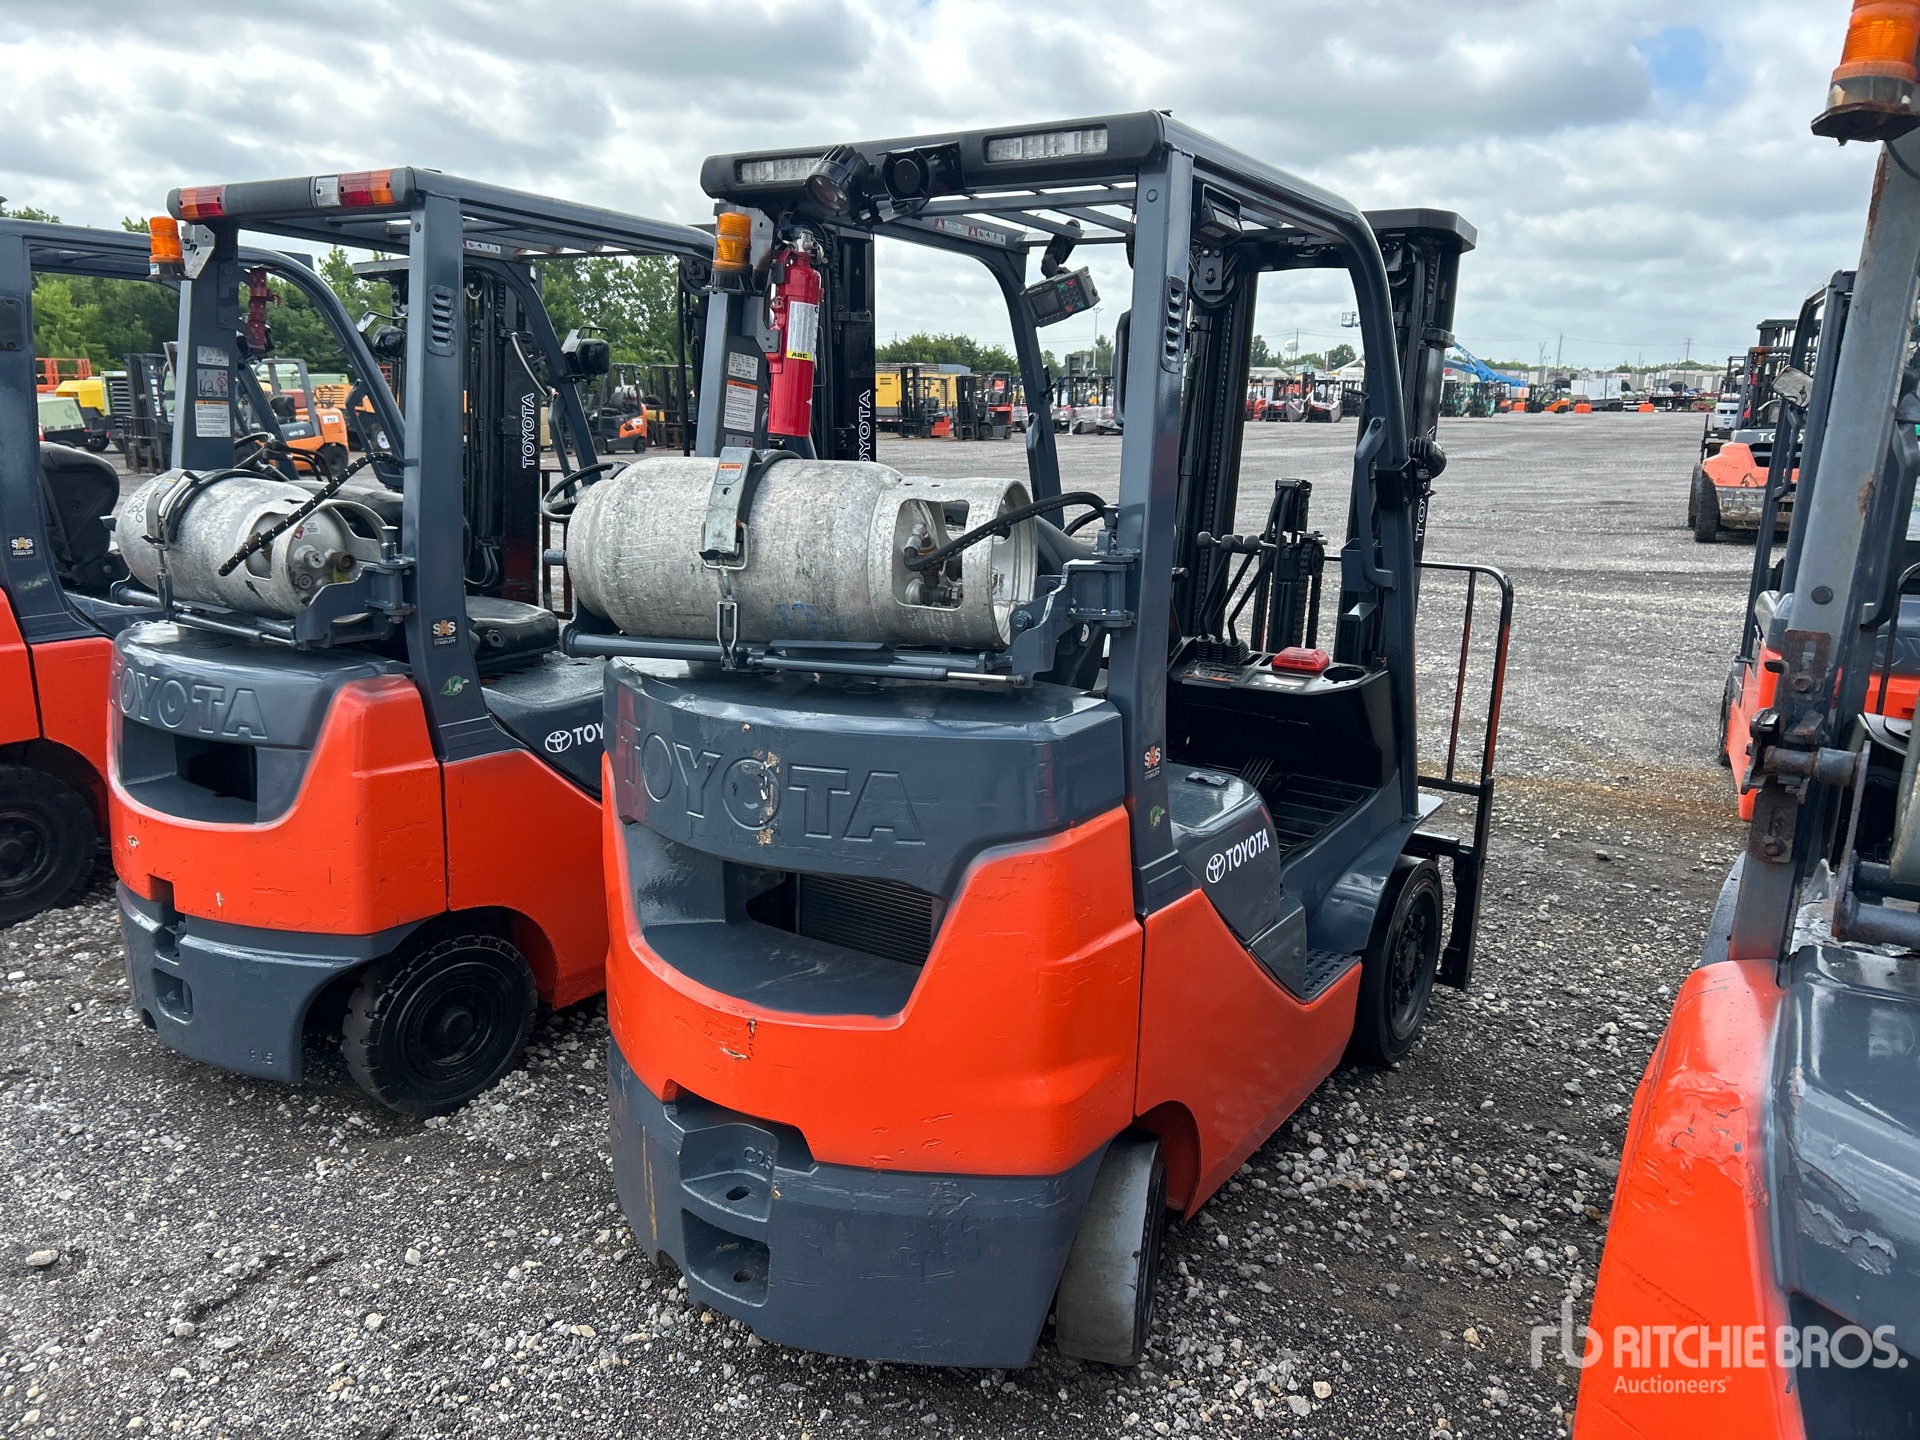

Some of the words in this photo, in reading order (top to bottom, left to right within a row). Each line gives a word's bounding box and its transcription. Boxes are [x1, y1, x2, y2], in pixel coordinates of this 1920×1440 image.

[521, 392, 535, 469] TOYOTA
[11, 536, 33, 549] SAS
[432, 619, 456, 637] SAS
[1144, 745, 1161, 769] SAS
[621, 718, 926, 846] TOYOTA
[1225, 828, 1270, 872] TOYOTA
